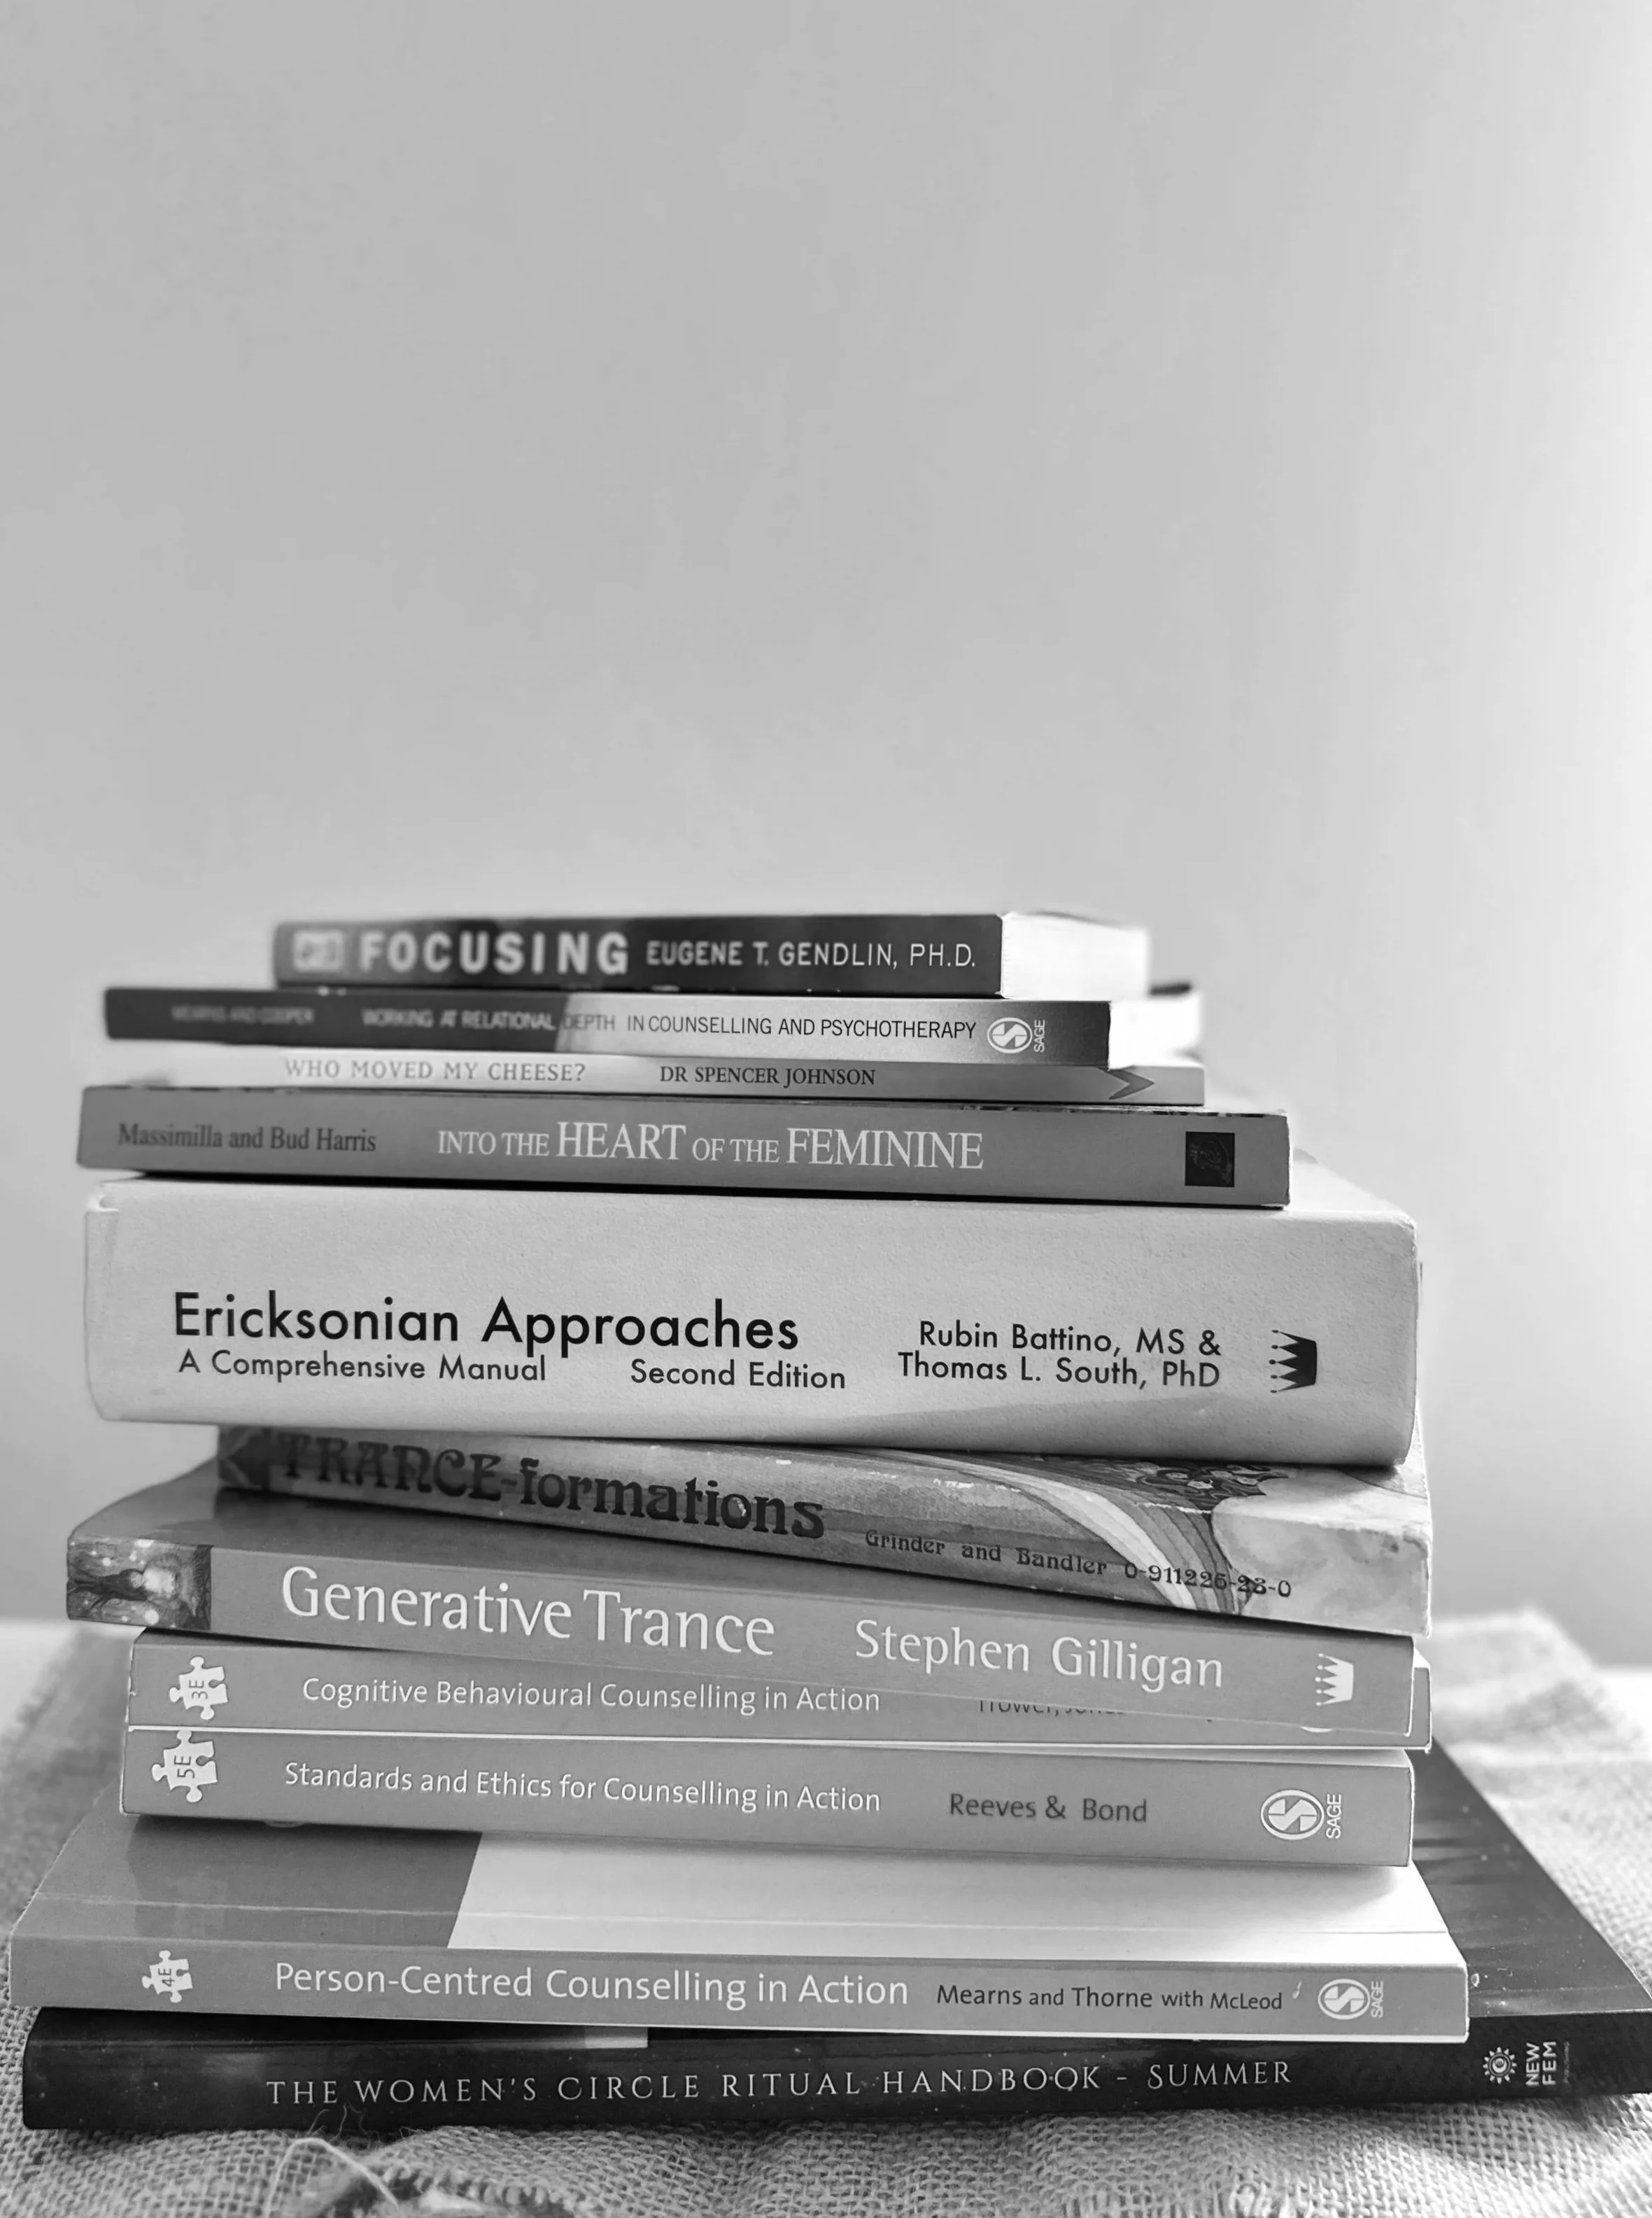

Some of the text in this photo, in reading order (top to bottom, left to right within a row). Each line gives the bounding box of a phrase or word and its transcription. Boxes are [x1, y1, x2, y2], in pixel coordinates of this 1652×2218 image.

[359, 930, 628, 975] FOCUSING
[645, 940, 976, 970] EUGENE T. GENDLIN, PH.D.
[461, 1010, 557, 1031] RELATIONAL
[563, 1013, 616, 1032] DEPTH
[628, 1015, 645, 1032] IN
[648, 1015, 772, 1035] COUNSELLING
[777, 1018, 815, 1036] AND
[821, 1019, 977, 1040] PSYCHOTHERAPY
[1033, 1019, 1046, 1053] SAGE
[285, 1059, 586, 1083] WHO MOVED MY CHEESE?
[660, 1067, 876, 1088] DR SPENCER JOHNSON
[118, 1123, 377, 1151] Massimilla and Bud Harris
[437, 1122, 984, 1170] INTO THE HEART OF THE FEMININE
[174, 1289, 799, 1358] Ericksonian Approaches
[919, 1319, 1222, 1356] Rubin Battino, MS &
[178, 1348, 546, 1383] A Comprehensive Manual
[630, 1358, 846, 1389] Second Edition
[898, 1352, 1220, 1390] Thomas L. South, PhD
[866, 1529, 946, 1556] Grinder
[961, 1543, 1001, 1562] and
[1016, 1547, 1107, 1576] Bandler
[281, 1565, 775, 1656] Generative Trance
[855, 1619, 1224, 1692] Stephen Gilligan
[188, 1679, 209, 1700] 3E
[303, 1677, 880, 1716] Cognitive Behavioural Counselling in Action
[174, 1755, 196, 1780] 5E
[285, 1762, 880, 1813] Standards and Ethics for Counselling in Action
[950, 1793, 1148, 1823] Reeves & Bond
[1326, 1793, 1343, 1839] SAGE
[276, 1962, 908, 2012] Person-Centred Counselling in Action
[936, 1985, 1283, 2011] Mearns and Thorne with McLeod
[1371, 1980, 1384, 2019] SAGE
[1525, 2042, 1540, 2086] NEW
[1542, 2041, 1557, 2085] FEM
[267, 2080, 338, 2104] THE
[353, 2077, 536, 2103] WOMEN'S
[558, 2075, 699, 2100] CIRCLE
[722, 2072, 860, 2098] RITUAL
[882, 2065, 1100, 2093] HANDBOOK
[1147, 2061, 1291, 2089] SUMMER
